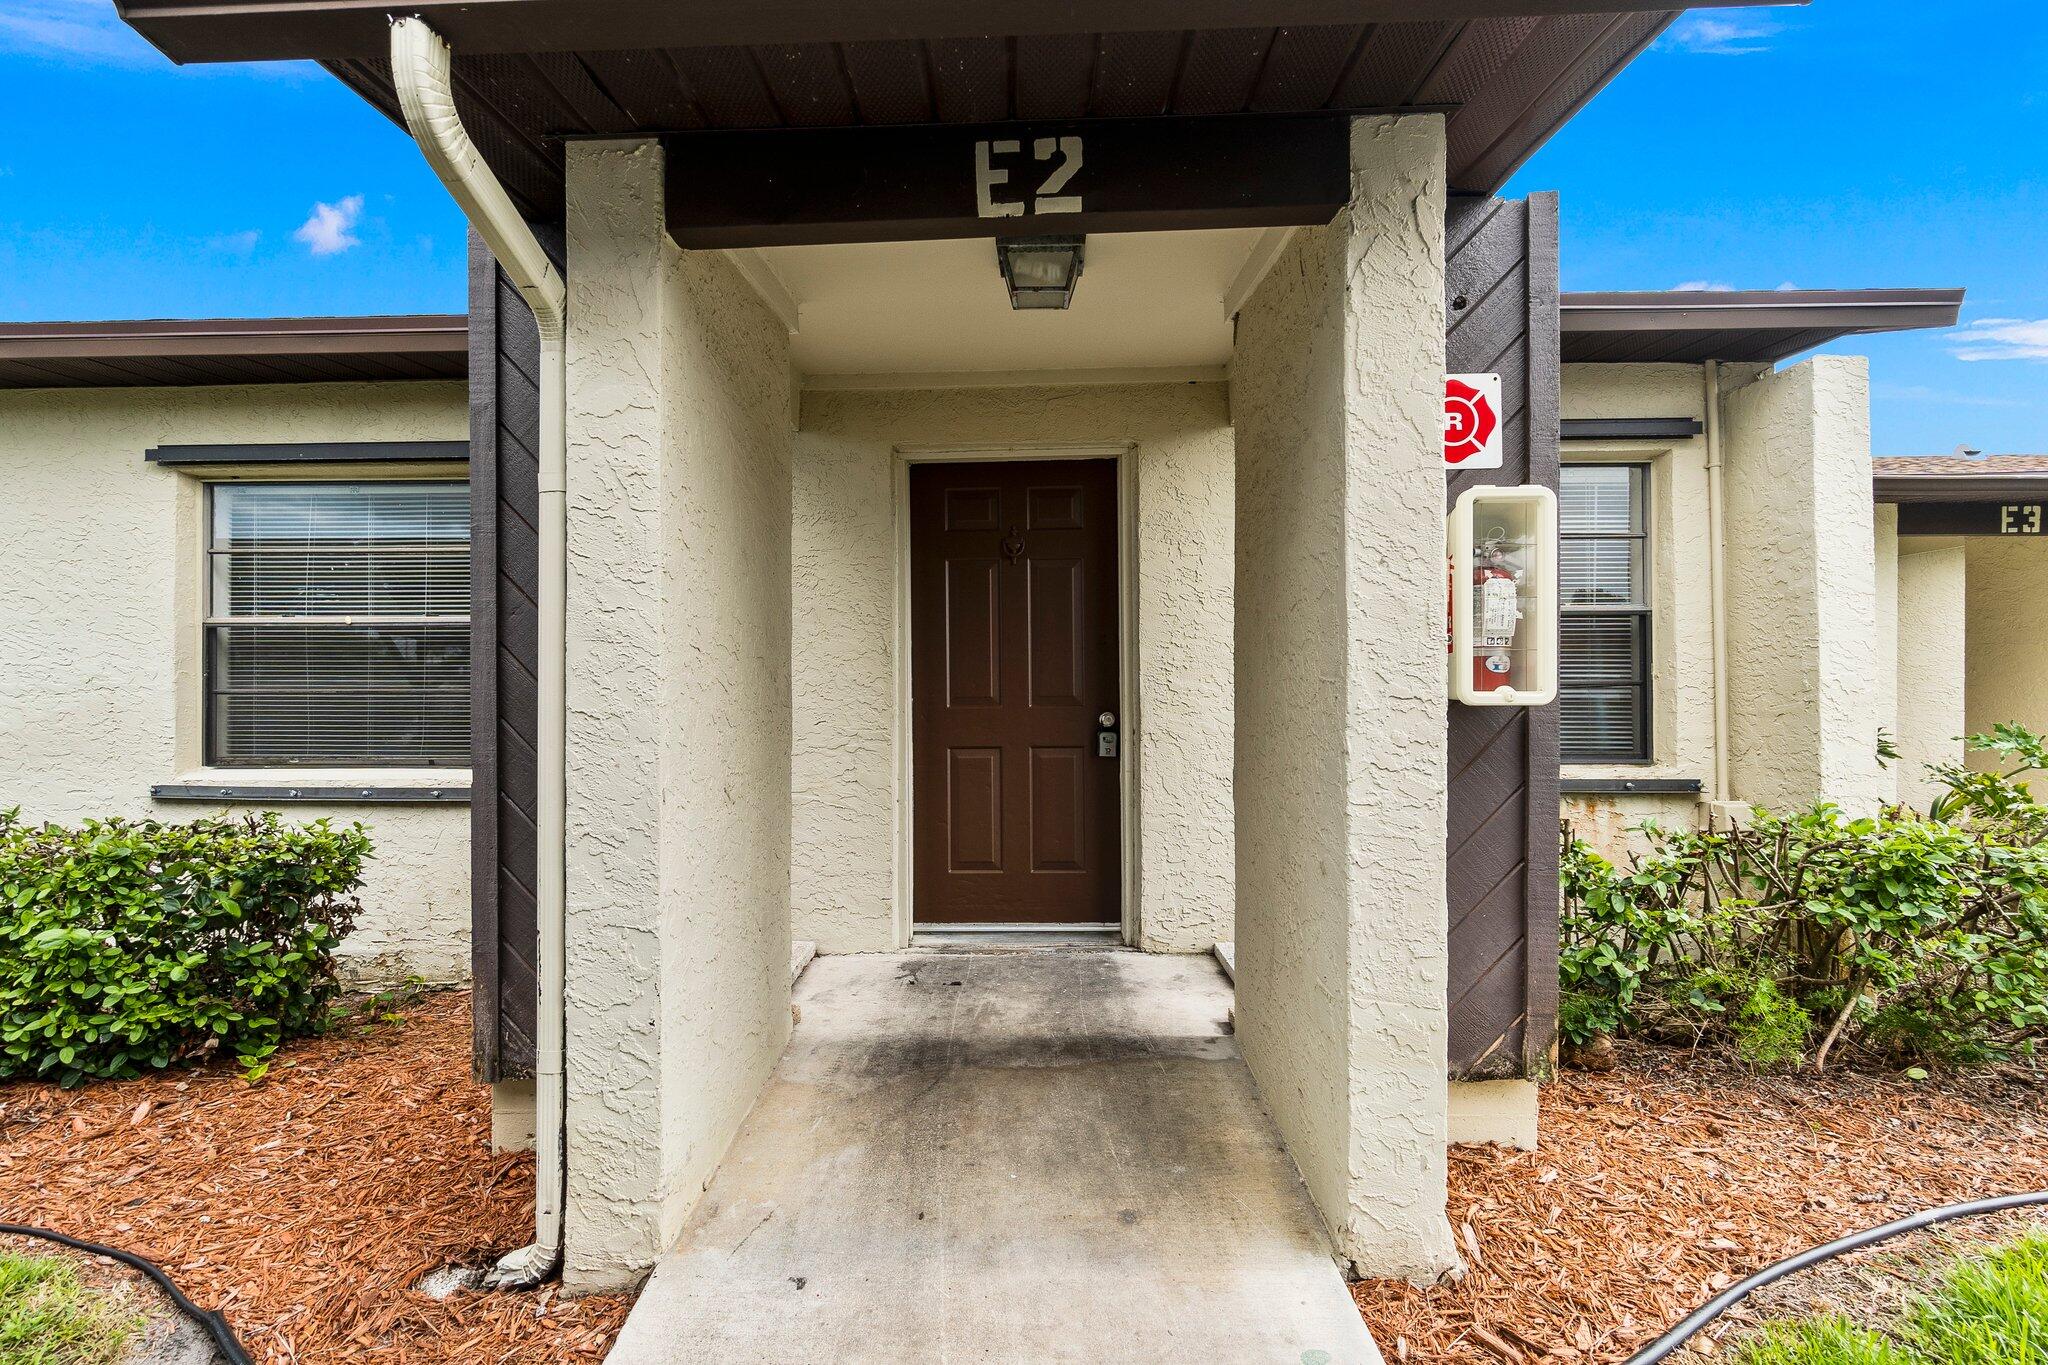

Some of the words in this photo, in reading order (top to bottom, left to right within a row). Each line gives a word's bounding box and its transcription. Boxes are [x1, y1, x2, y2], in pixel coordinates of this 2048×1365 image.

[975, 136, 1083, 218] E2
[1443, 412, 1463, 431] R
[2001, 505, 2042, 533] E3
